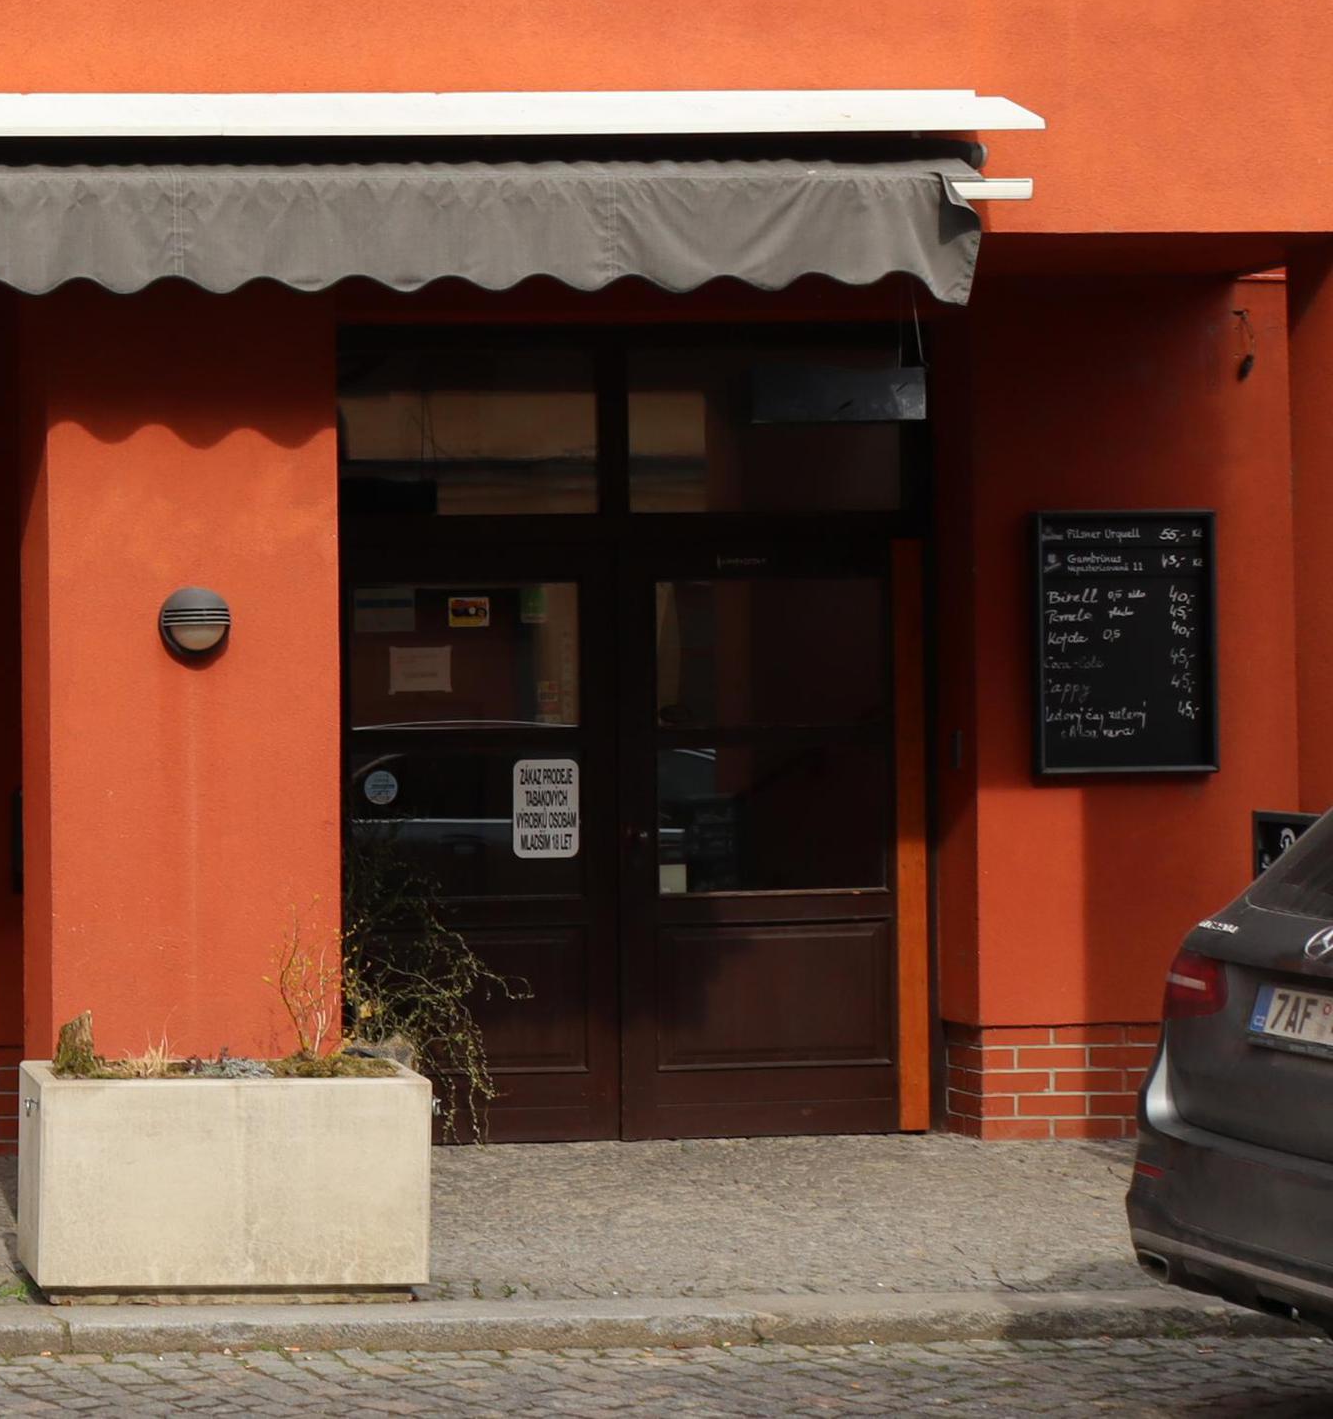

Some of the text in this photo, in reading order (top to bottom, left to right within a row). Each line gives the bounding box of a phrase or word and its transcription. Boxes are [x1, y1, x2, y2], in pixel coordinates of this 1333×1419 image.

[1066, 528, 1101, 539] Pilsner
[1104, 527, 1141, 543] Urquell
[1158, 527, 1186, 543] 55,-
[1066, 552, 1122, 564] Gambrinus
[1046, 587, 1098, 604] Birell
[1047, 630, 1089, 653] Kofola
[1103, 628, 1121, 643] 0,5
[520, 765, 573, 785] ZÁKAZ PRODEJE
[525, 786, 568, 807] TABÁKOVÝCH
[516, 807, 577, 829] VÝROBKŮ OSOBÁM
[520, 830, 573, 850] MLADŠÍM 18 LET
[1270, 992, 1318, 1035] 7AF
